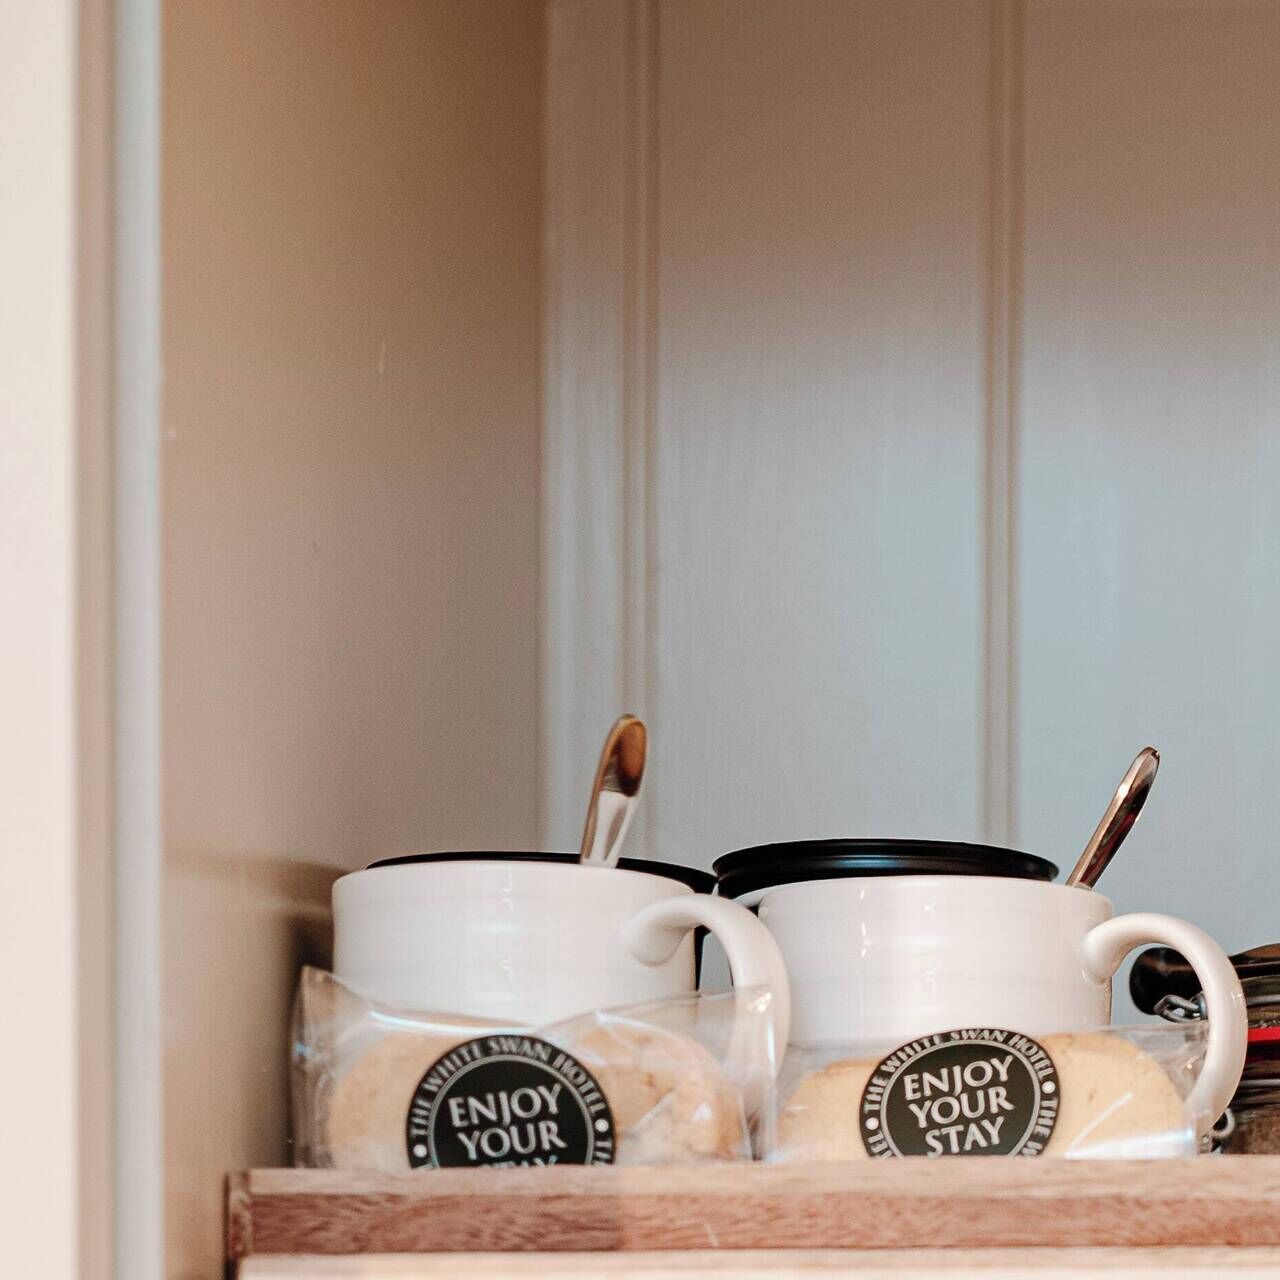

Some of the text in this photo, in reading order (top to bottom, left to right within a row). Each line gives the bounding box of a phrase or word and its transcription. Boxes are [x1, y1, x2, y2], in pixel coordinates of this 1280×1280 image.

[411, 1097, 432, 1137] THE
[487, 1037, 550, 1062] SWAN
[552, 1053, 607, 1115] HOTEL
[864, 1077, 888, 1113] THE
[949, 1029, 1008, 1042] SWAN
[1008, 1033, 1055, 1082] HOTEL
[904, 1055, 1014, 1101] ENJOY
[449, 1083, 562, 1128] ENJOY
[908, 1086, 1016, 1128] YOUR
[457, 1121, 568, 1160] YOUR
[925, 1116, 1006, 1158] STAY
